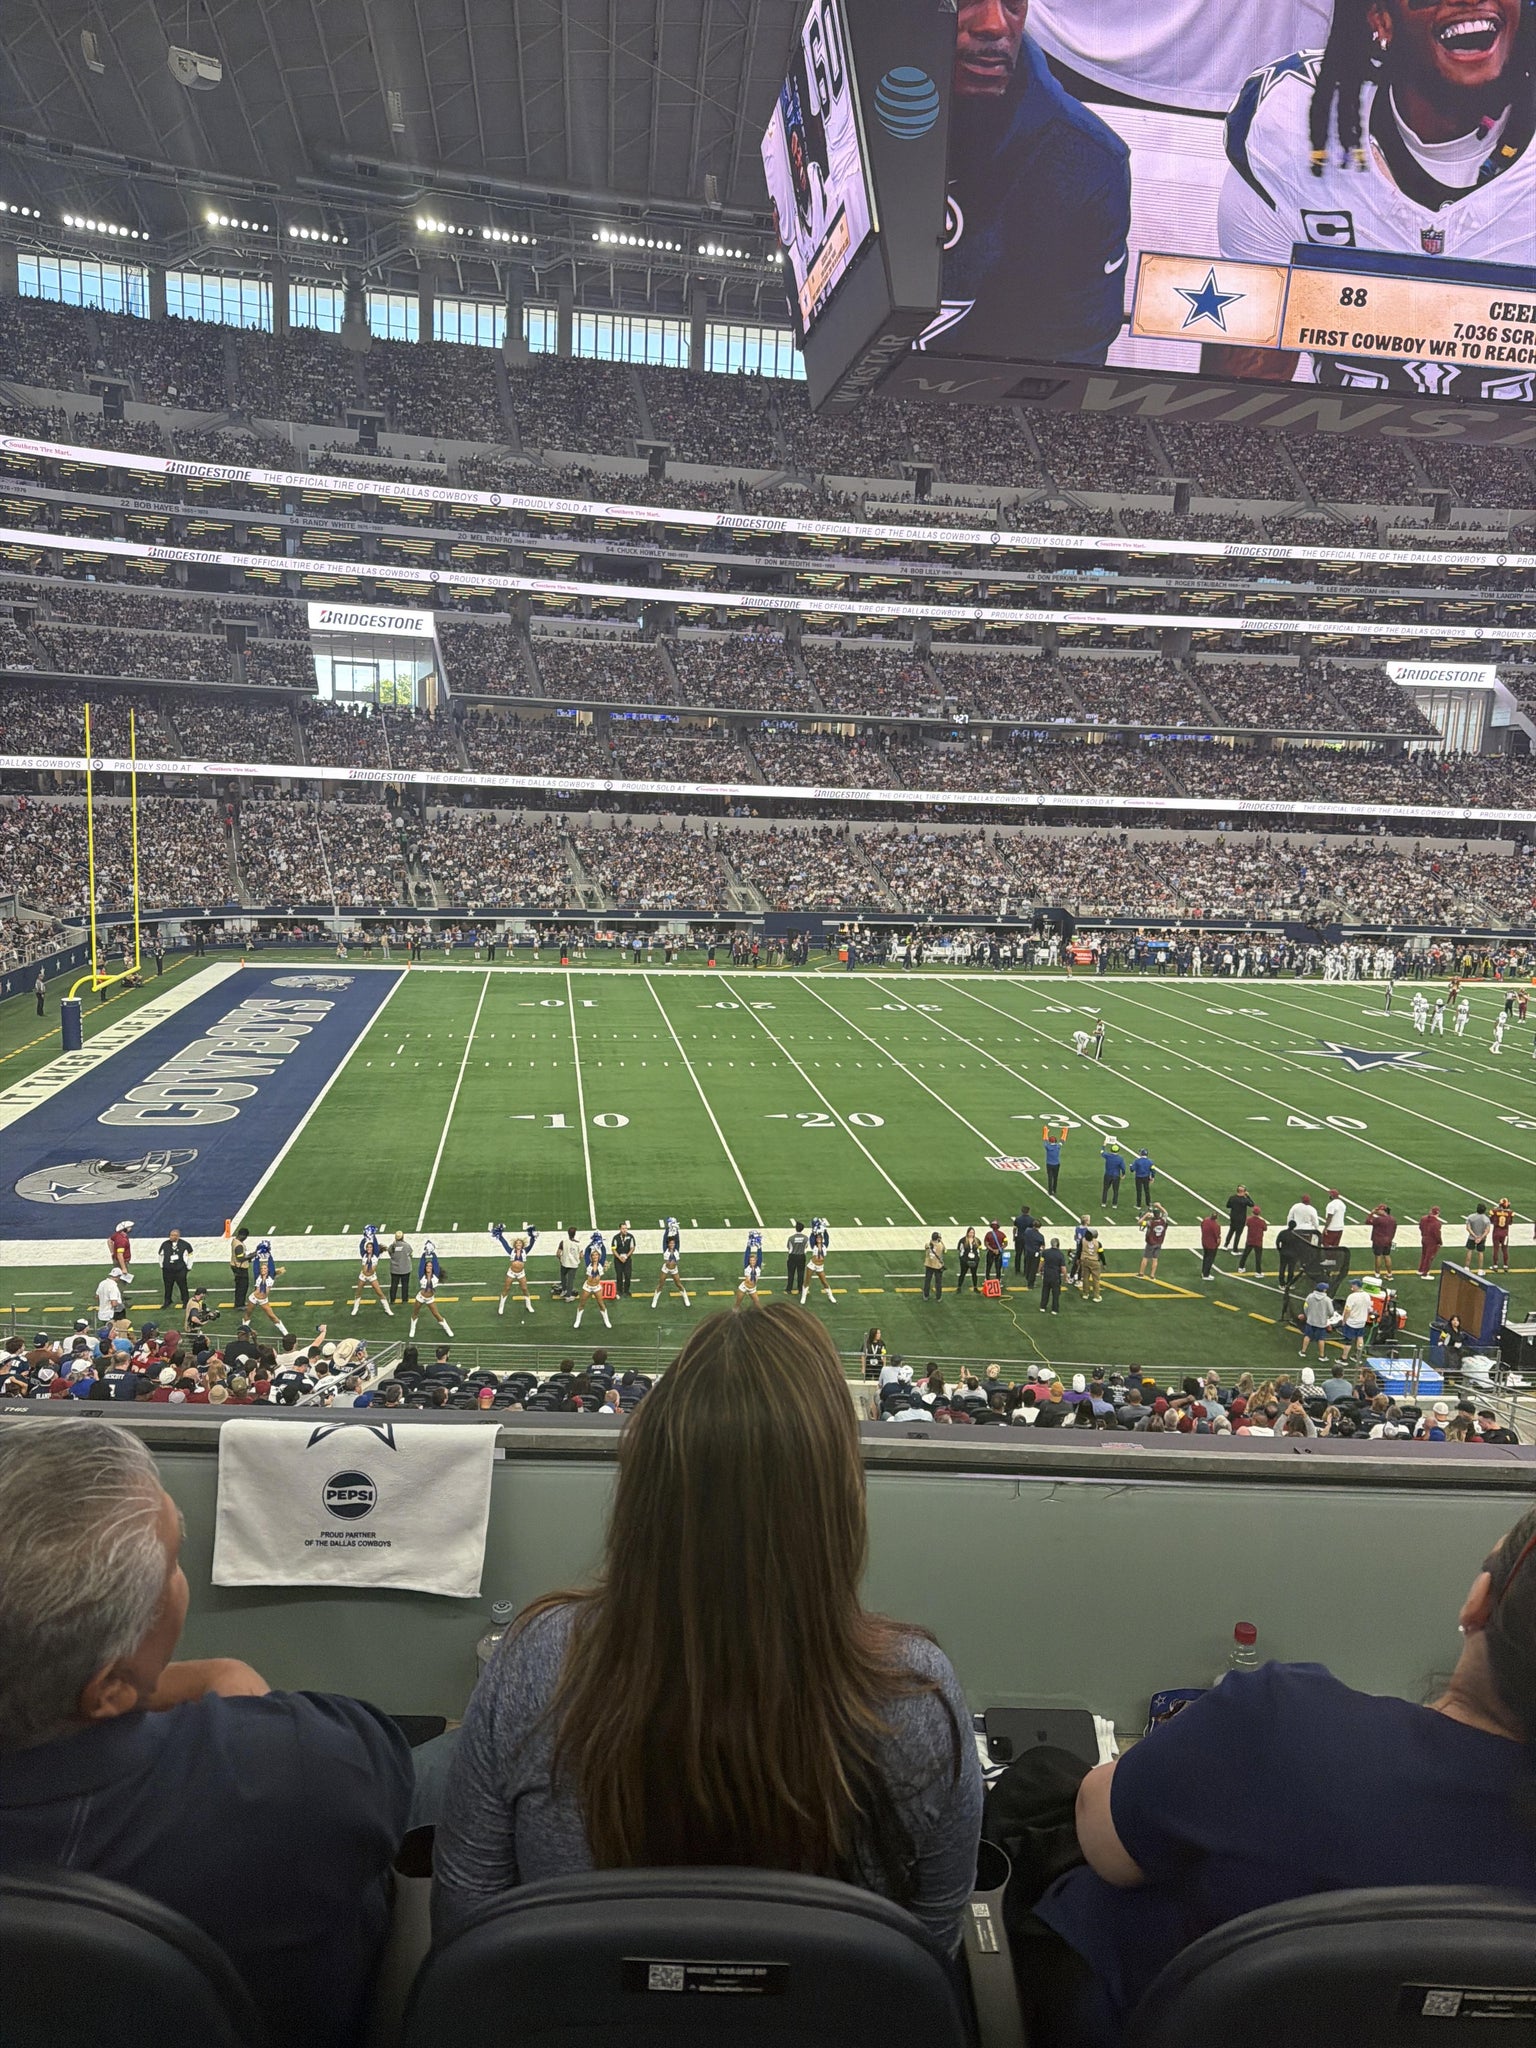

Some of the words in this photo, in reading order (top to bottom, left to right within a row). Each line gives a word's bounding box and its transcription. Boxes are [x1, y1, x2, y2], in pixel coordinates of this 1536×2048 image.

[1340, 287, 1368, 308] 88
[1454, 323, 1498, 342] 7,036
[1300, 328, 1349, 348] FIRST
[1352, 332, 1425, 354] COWBOY
[1429, 340, 1457, 358] WR
[1462, 343, 1481, 359] TO
[831, 334, 912, 402] WINSTAR
[10, 442, 38, 452] Southern
[166, 461, 251, 481] BRIDGESTONE
[264, 473, 282, 483] THE
[286, 475, 328, 487] OFFICIAL
[333, 480, 353, 490] TIRE
[357, 482, 370, 492] OF
[374, 485, 391, 494] THE
[394, 487, 430, 497] DALLAS
[432, 490, 478, 502] COWBOYS
[134, 501, 152, 509] BOB
[154, 503, 180, 512] HAYES
[512, 498, 552, 509] PROUDLY
[556, 502, 579, 511] SOLD
[582, 504, 593, 513] AT
[302, 519, 329, 527] RANDY
[331, 521, 356, 529] WHITE
[716, 515, 787, 530] BRIDGESTONE
[797, 522, 812, 531] THE
[815, 524, 851, 534] OFFICIAL
[854, 526, 872, 535] TIRE
[874, 528, 886, 536] OF
[888, 528, 904, 537] THE
[907, 530, 937, 539] DALLAS
[940, 531, 980, 541] COWBOYS
[486, 535, 512, 543] RENFRO
[1010, 536, 1047, 545] PROUDLY
[1050, 538, 1071, 546] SOLD
[617, 547, 638, 555] CHUCK
[640, 549, 666, 557] HOWLEY
[1223, 545, 1293, 557] BRIDGESTONE
[1320, 550, 1356, 559] OFFICIAL
[1410, 553, 1442, 562] DALLAS
[1444, 554, 1486, 564] COWBOYS
[148, 547, 222, 563] BRIDGESTONE
[232, 556, 249, 564] THE
[252, 558, 290, 568] OFFICIAL
[293, 561, 310, 570] TIRE
[345, 565, 377, 575] DALLAS
[380, 568, 420, 578] COWBOYS
[450, 575, 486, 584] PROUDLY
[488, 578, 509, 586] SOLD
[741, 596, 801, 608] BRIDGESTONE
[824, 603, 856, 611] OFFICIAL
[931, 608, 966, 616] COWBOYS
[320, 610, 424, 630] BRIDGESTONE
[991, 611, 1023, 619] PROUDLY
[1241, 620, 1300, 630] BRIDGESTONE
[1401, 626, 1428, 635] DALLAS
[1430, 628, 1466, 636] COWBOYS
[1396, 668, 1486, 682] BRIDGESTONE
[0, 758, 33, 767] DALLAS
[36, 759, 81, 768] COWBOYS
[115, 762, 154, 771] PROUDLY
[156, 763, 178, 771] SOLD
[349, 770, 416, 782] BRIDGESTONE
[443, 775, 478, 784] OFFICIAL
[559, 780, 595, 788] COWBOYS
[622, 783, 655, 791] PROUDLY
[814, 789, 872, 799] BRIDGESTONE
[1238, 802, 1296, 811] BRIDGESTONE
[133, 1009, 172, 1019] US
[114, 1021, 152, 1031] OF
[84, 1034, 133, 1050] ALL
[97, 998, 336, 1126] COWBOYS
[21, 1054, 102, 1086] TAKES
[0, 1093, 43, 1105] IT
[1496, 1116, 1536, 1130] 5
[1000, 1160, 1032, 1169] NFL
[602, 1284, 612, 1296] 10
[988, 1282, 999, 1294] 20
[326, 1489, 373, 1501] PEPSI
